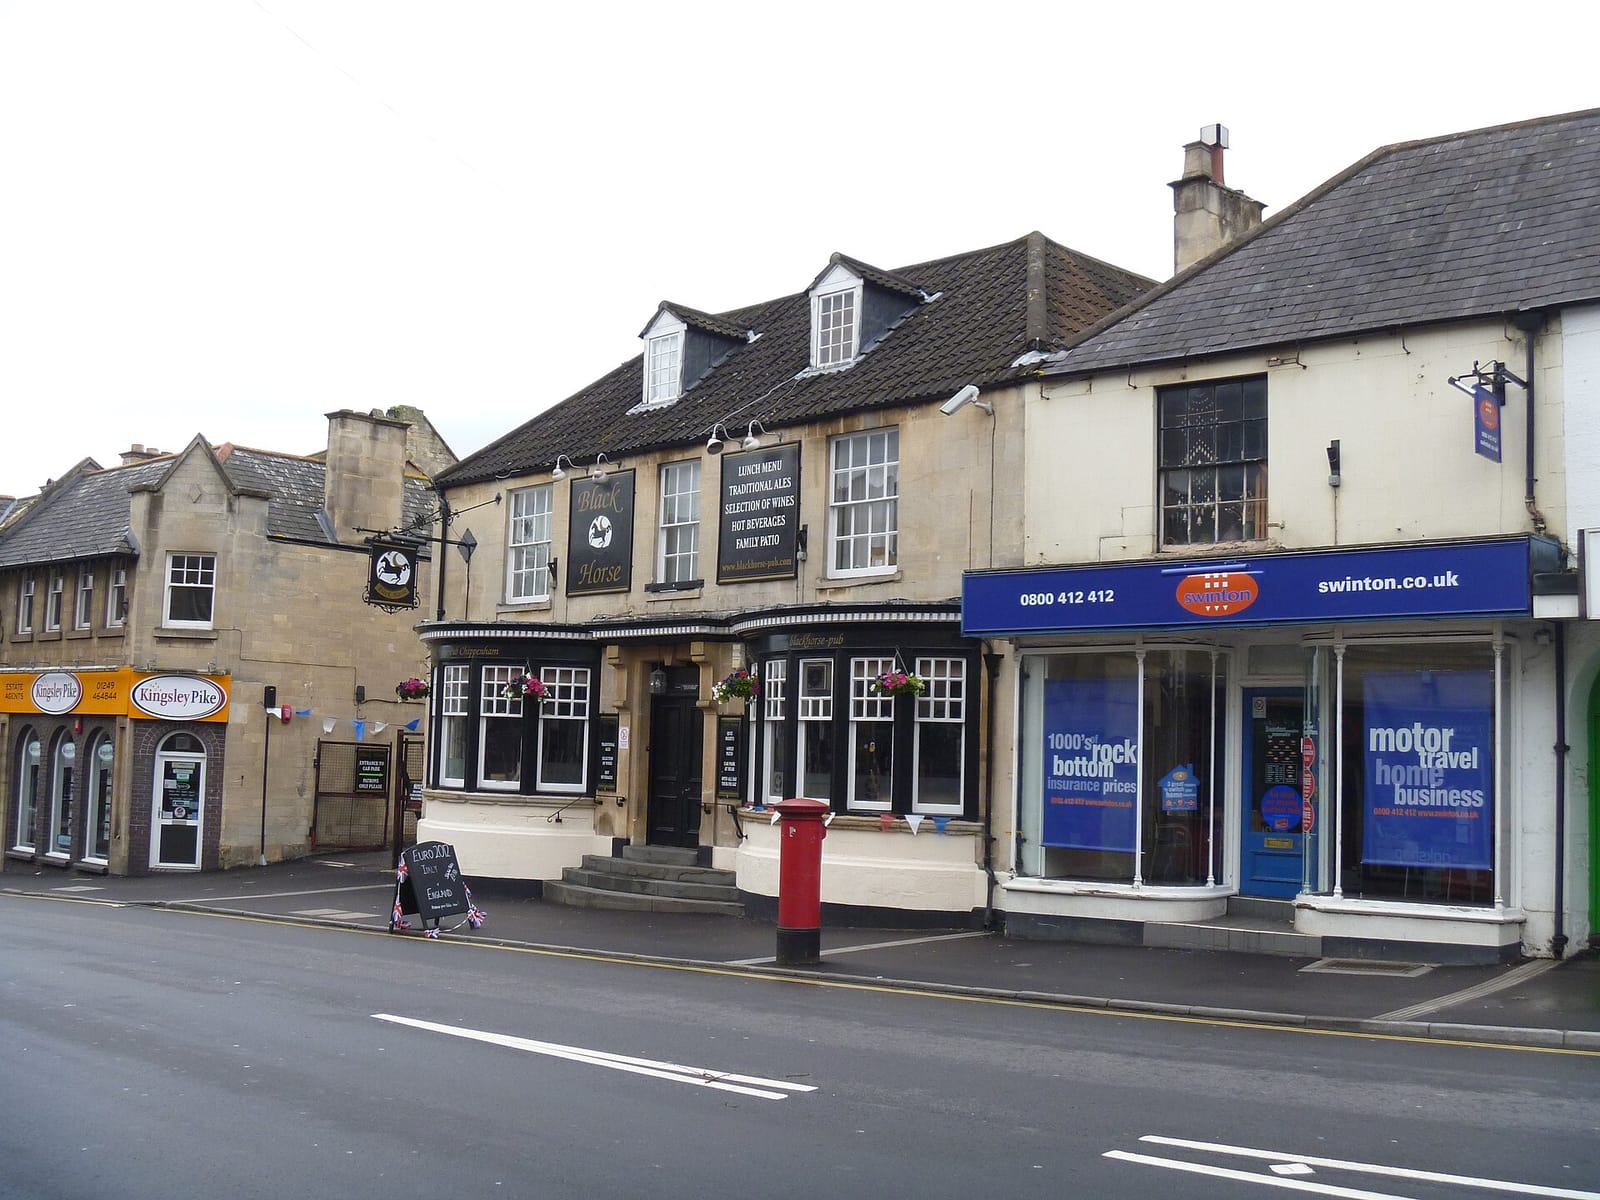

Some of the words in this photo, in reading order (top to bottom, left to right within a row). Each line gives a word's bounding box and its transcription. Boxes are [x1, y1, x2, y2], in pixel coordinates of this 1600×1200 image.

[738, 463, 761, 477] LUNCH
[761, 459, 783, 473] MENU
[729, 480, 773, 496] TRADITIONAL
[773, 477, 792, 489] ALES
[578, 481, 624, 513] Black
[725, 499, 761, 515] SELECTION
[761, 498, 772, 510] OF
[772, 495, 795, 509] WINES
[731, 519, 746, 532] HOT
[746, 515, 786, 530] BEVERAGES
[735, 536, 760, 550] FAMILY
[760, 534, 780, 547] PATIO
[578, 559, 622, 585] Horse
[1318, 570, 1459, 594] swinton.co.uk
[1020, 593, 1055, 607] 0800
[1057, 591, 1084, 605] 412
[1087, 589, 1115, 603] 412
[1184, 588, 1251, 605] swinton
[5, 683, 24, 691] ESTATE
[35, 682, 63, 702] Kingsley
[62, 683, 77, 698] Pike
[96, 681, 115, 690] 01249
[5, 692, 24, 700] AGENTS
[92, 691, 117, 701] 464844
[140, 688, 190, 707] Kingsley
[191, 690, 217, 705] Pike
[1048, 733, 1092, 751] 1000's
[1369, 722, 1454, 753] motor
[1092, 739, 1137, 764] rock
[1418, 746, 1478, 769] travel
[1053, 754, 1114, 778] bottom
[1375, 758, 1445, 787] home
[1047, 776, 1100, 792] insurance
[1103, 779, 1137, 795] prices
[1394, 783, 1484, 808] business
[1391, 808, 1404, 817] 412
[1404, 808, 1417, 817] 412
[412, 848, 434, 863] EURO
